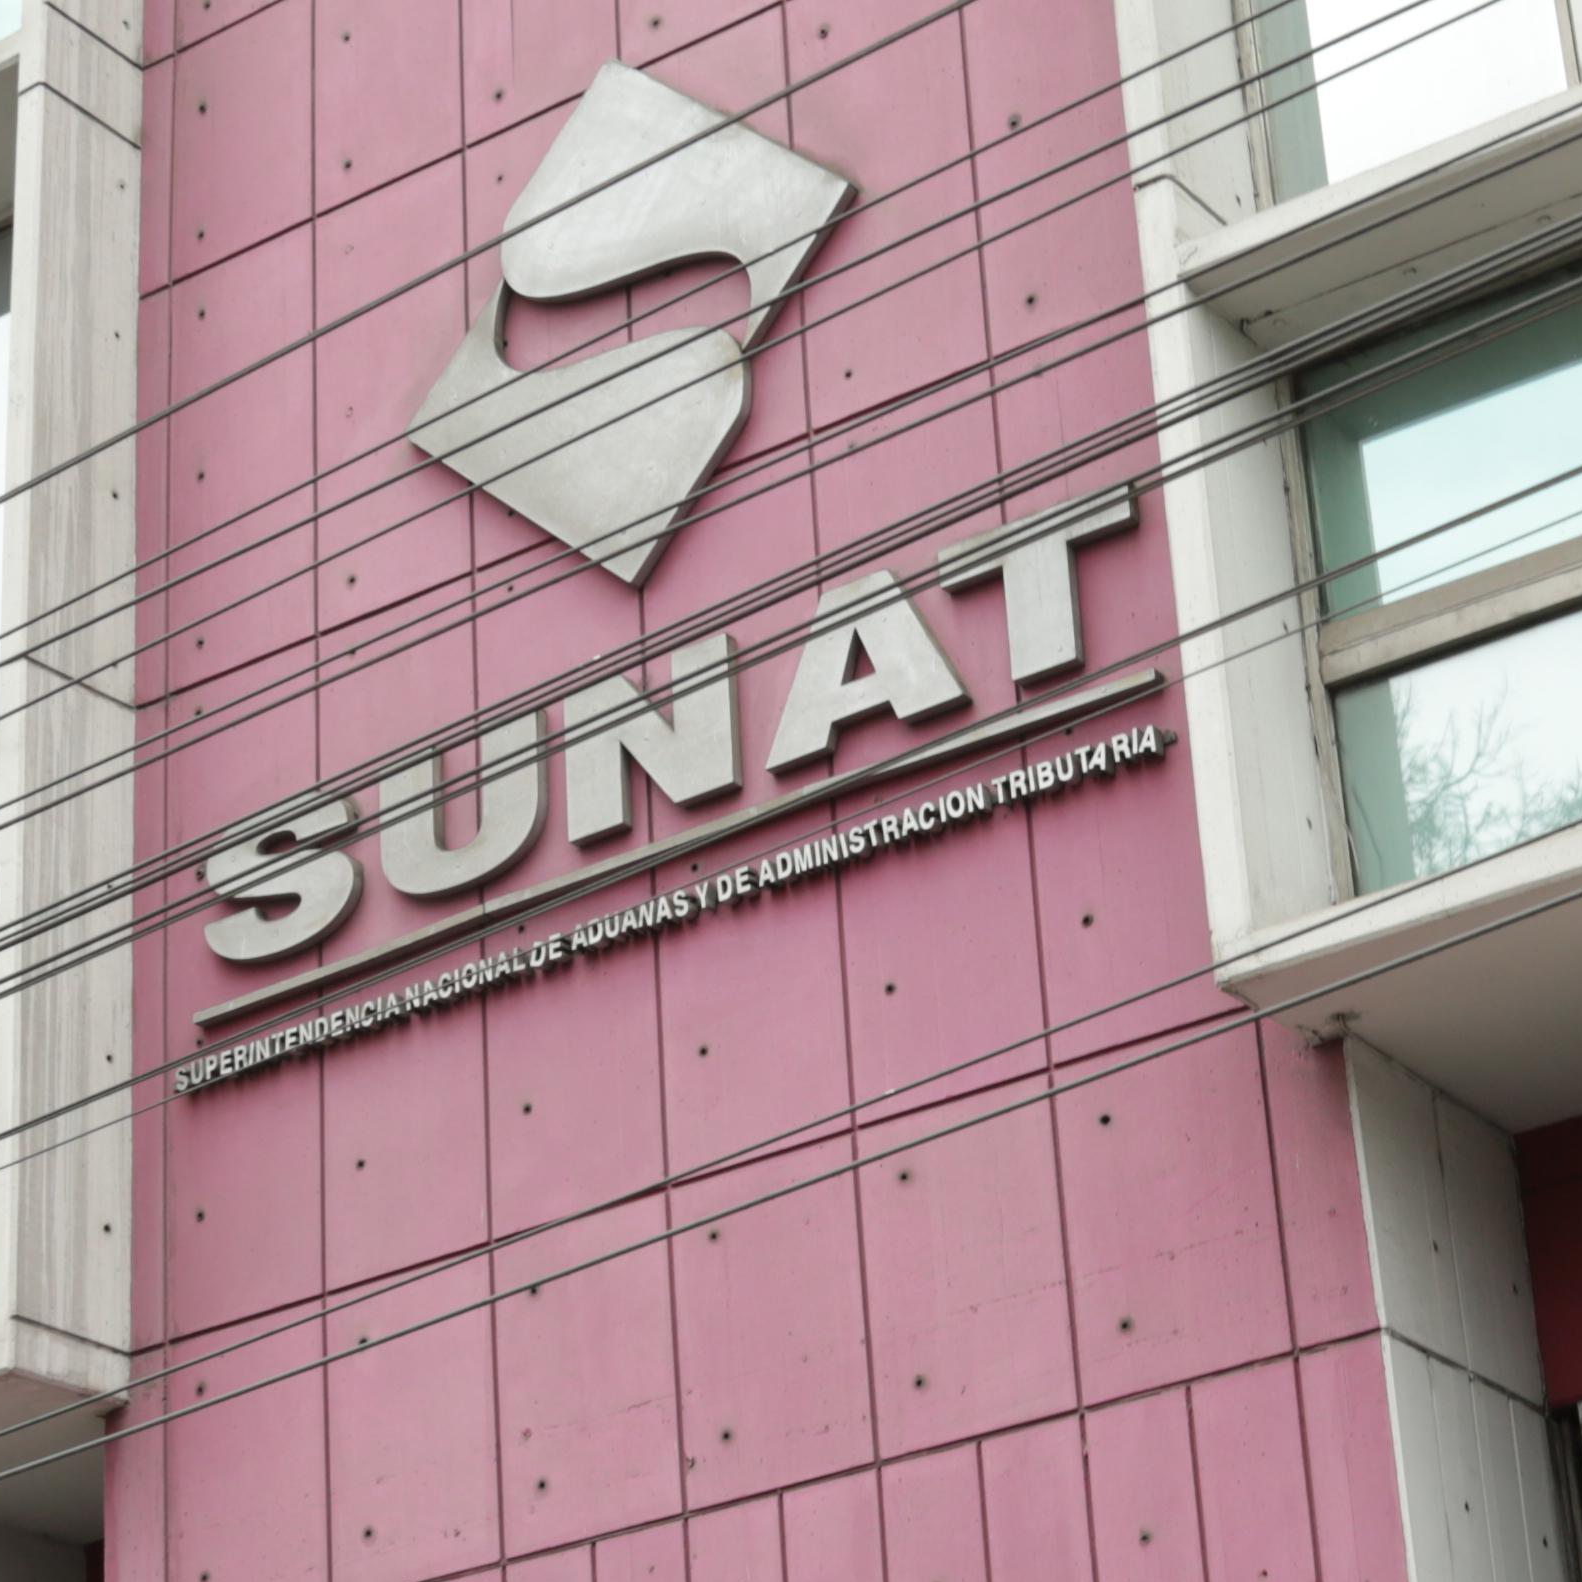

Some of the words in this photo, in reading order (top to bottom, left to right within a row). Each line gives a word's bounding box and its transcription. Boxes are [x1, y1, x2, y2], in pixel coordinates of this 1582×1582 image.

[175, 992, 400, 1092] SUPERINTENDENCIA
[405, 946, 526, 1012] NACIONAL
[529, 932, 563, 968] DE
[570, 889, 690, 951] ADUANAS
[695, 881, 709, 909] Y
[717, 866, 752, 903] DE
[758, 783, 985, 888] ADMINISTRACION
[991, 725, 1157, 804] TRIBUTARIA
[203, 482, 1143, 966] SUNAT
